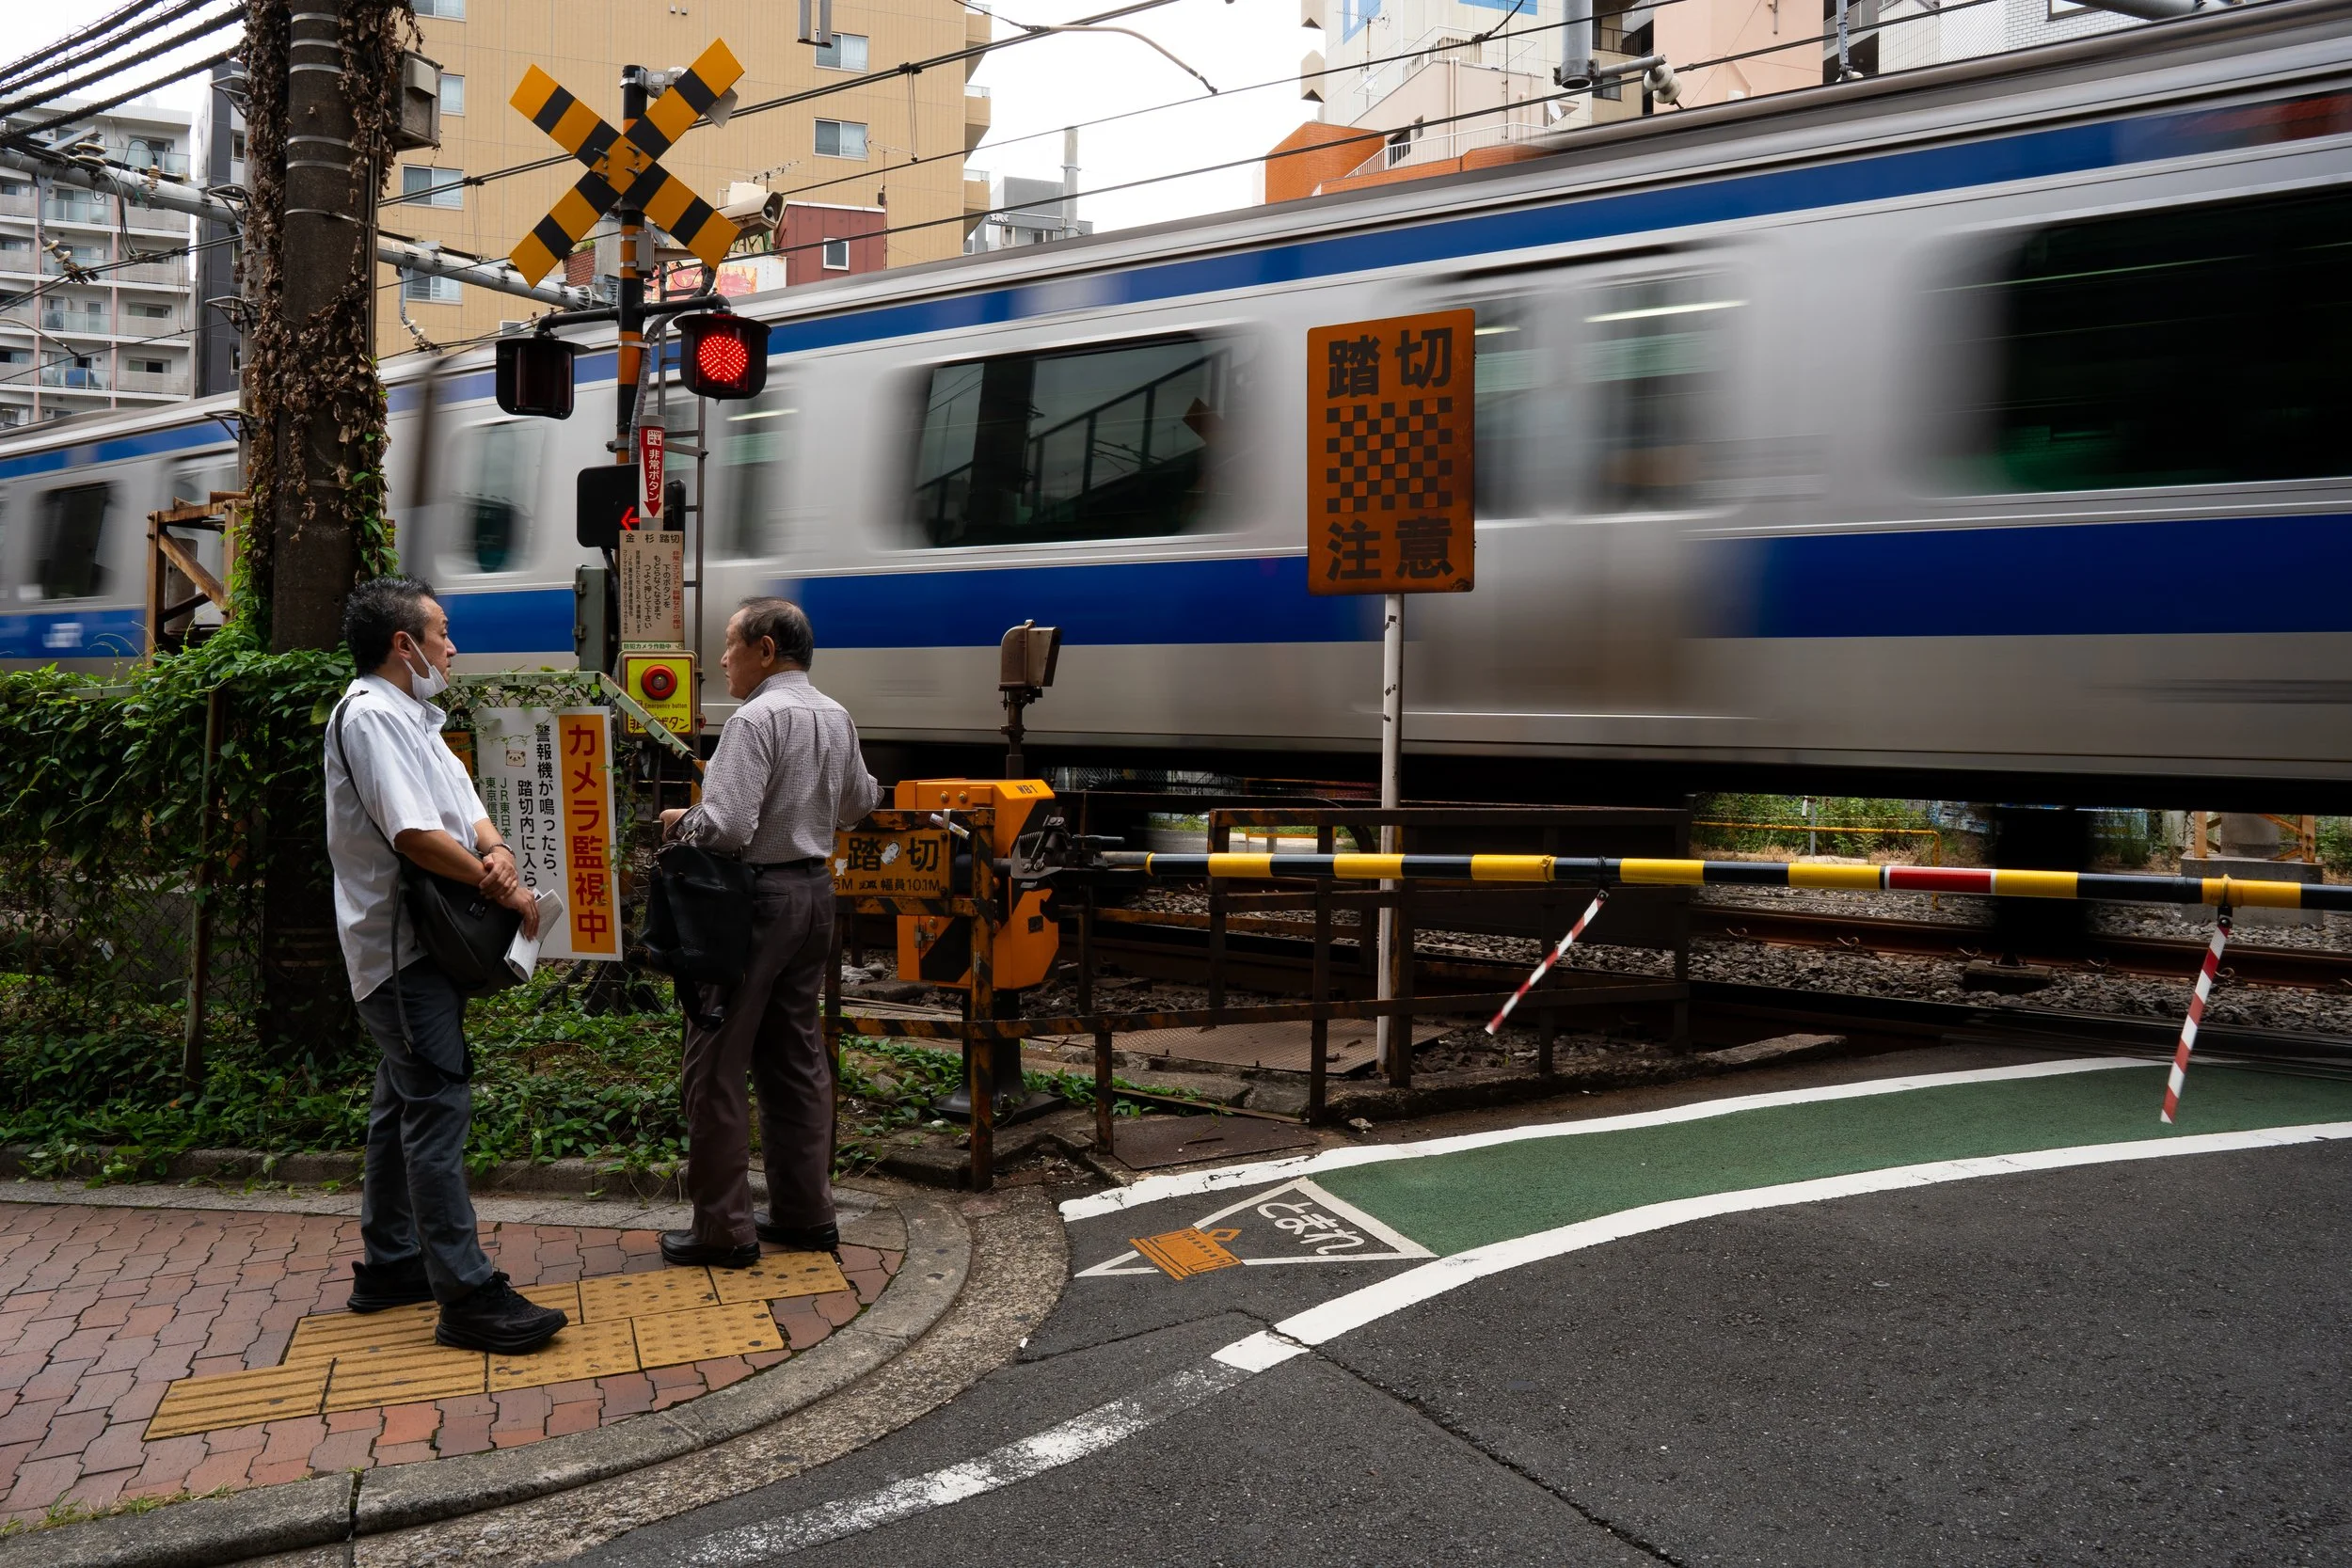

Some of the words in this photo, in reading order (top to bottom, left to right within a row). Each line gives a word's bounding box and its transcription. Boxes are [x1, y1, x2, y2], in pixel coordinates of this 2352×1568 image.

[1327, 326, 1454, 399] 踏切
[648, 449, 660, 501] 非常ボタン
[1326, 515, 1454, 582] 注意
[644, 564, 652, 629] つよく押して下さい
[662, 564, 671, 609] 下のボタンを
[629, 716, 689, 730] 非ボタン
[500, 777, 512, 839] JR東日本
[535, 724, 558, 883] 警報機が鳴ったら、
[1016, 784, 1039, 795] WB1
[568, 724, 608, 944] カメラ監視中
[847, 836, 940, 872] 踏切
[1257, 1201, 1365, 1256] とまれ
